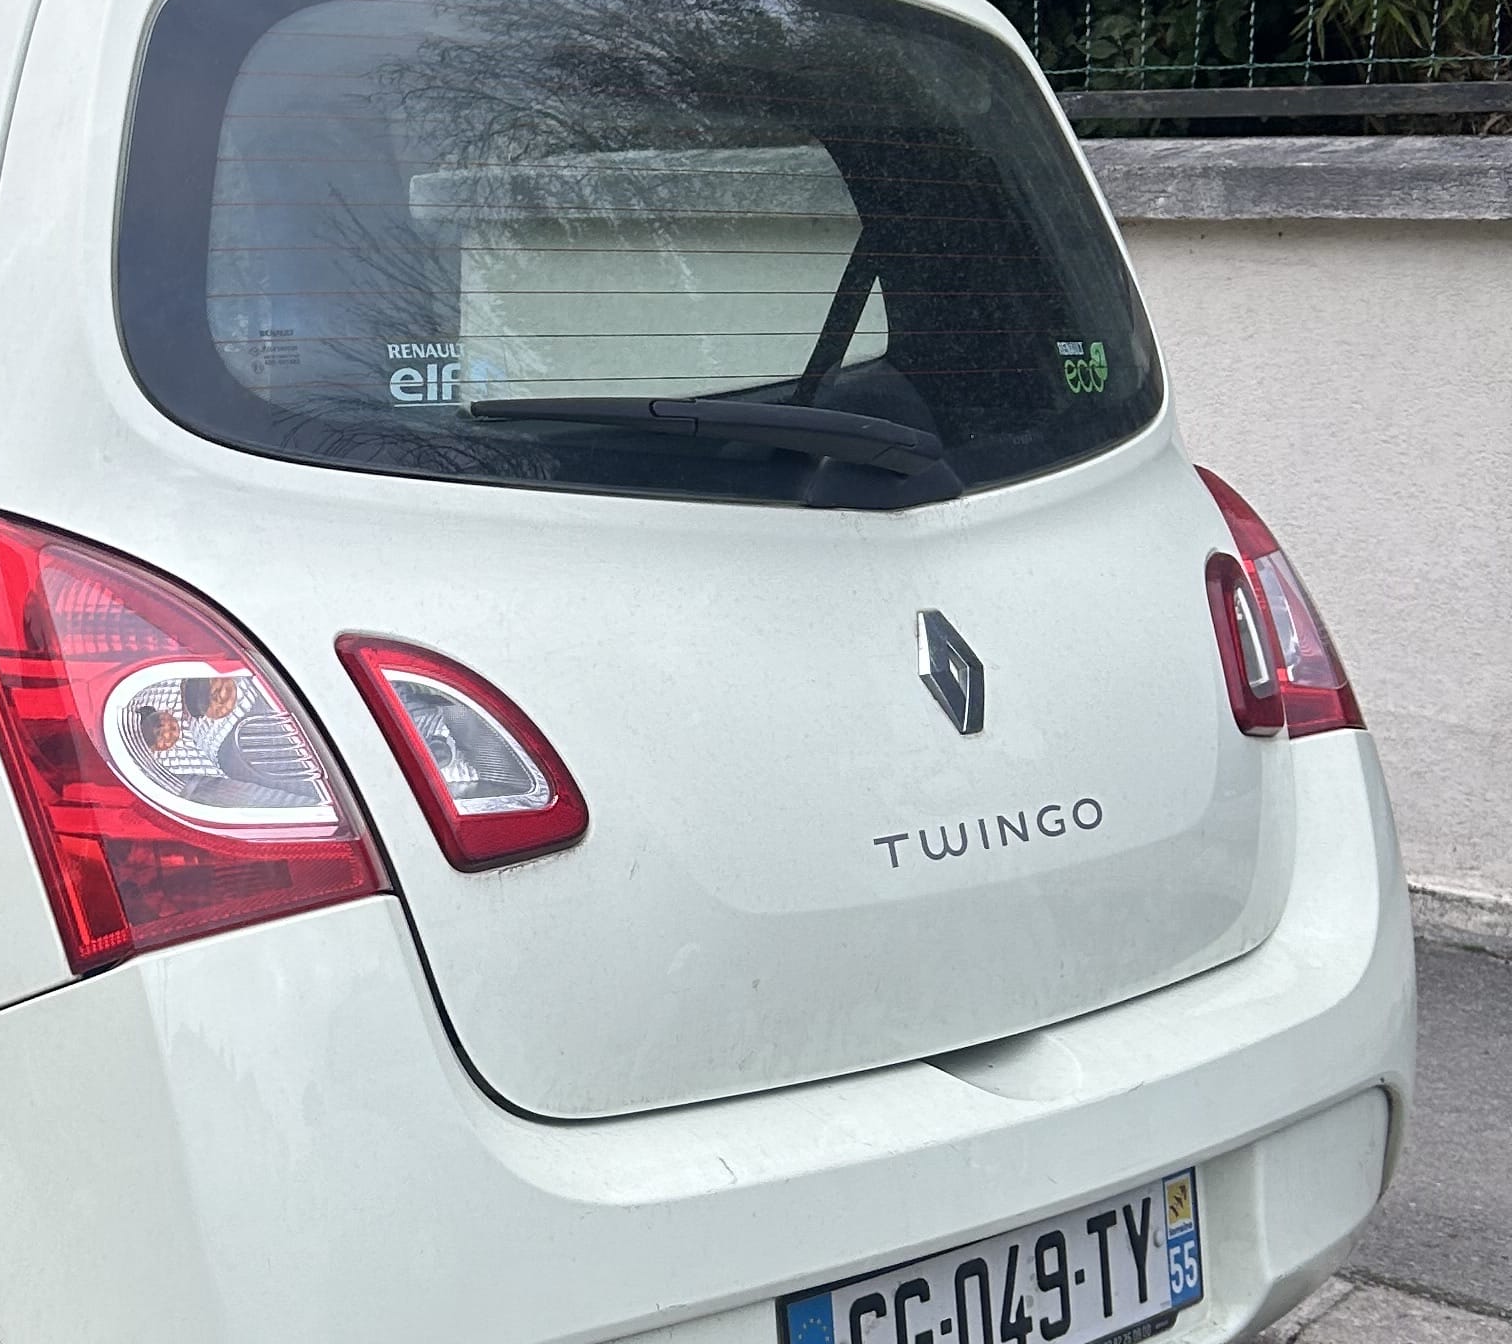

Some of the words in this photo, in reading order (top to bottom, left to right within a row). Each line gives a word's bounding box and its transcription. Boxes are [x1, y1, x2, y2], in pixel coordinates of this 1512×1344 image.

[387, 343, 466, 359] RENAULT
[389, 362, 462, 402] elf
[873, 797, 1103, 869] TWINGO
[1169, 1239, 1198, 1295] 55
